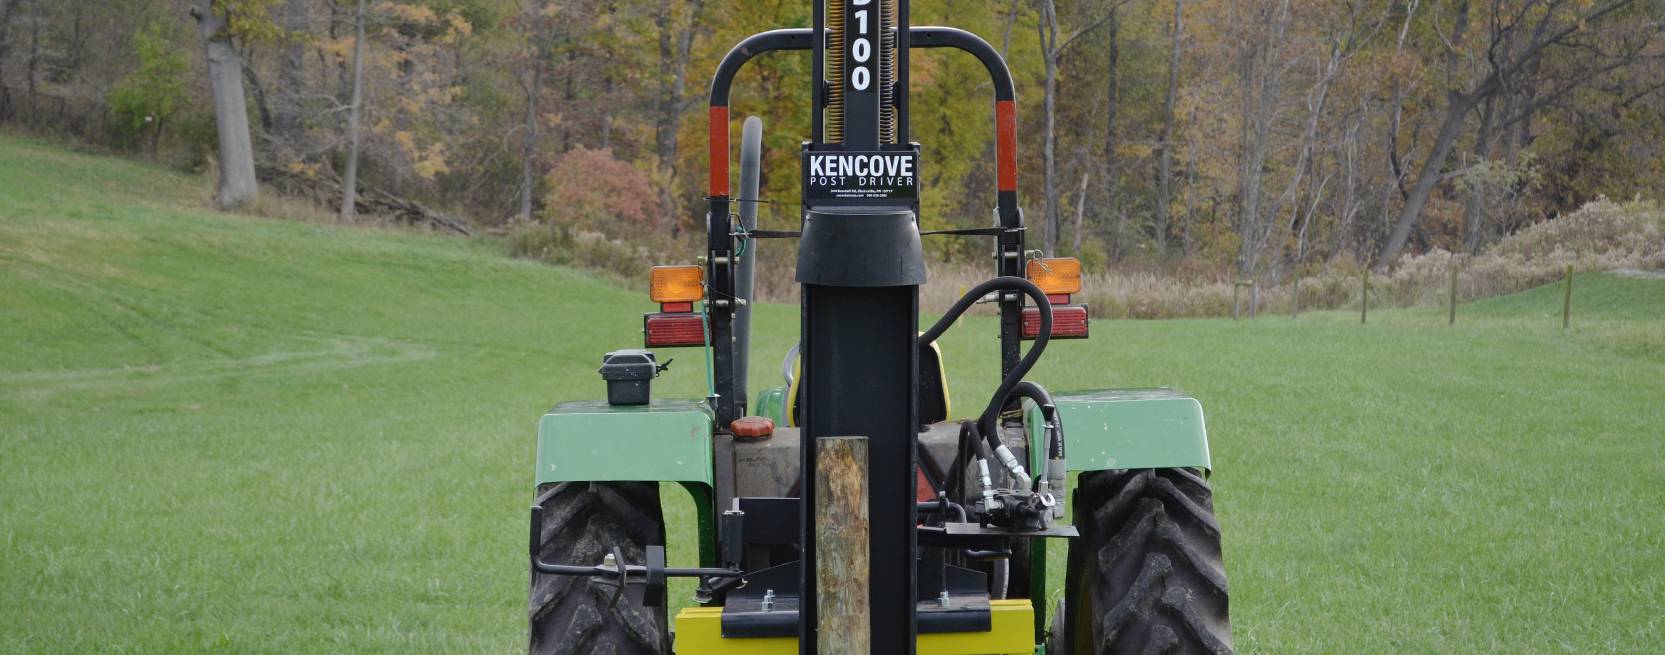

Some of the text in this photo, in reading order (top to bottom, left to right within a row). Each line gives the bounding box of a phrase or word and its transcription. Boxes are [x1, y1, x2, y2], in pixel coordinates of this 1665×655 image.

[852, 0, 871, 91] 100
[810, 155, 913, 177] KENCOVE
[810, 177, 913, 186] POST DRIVER
